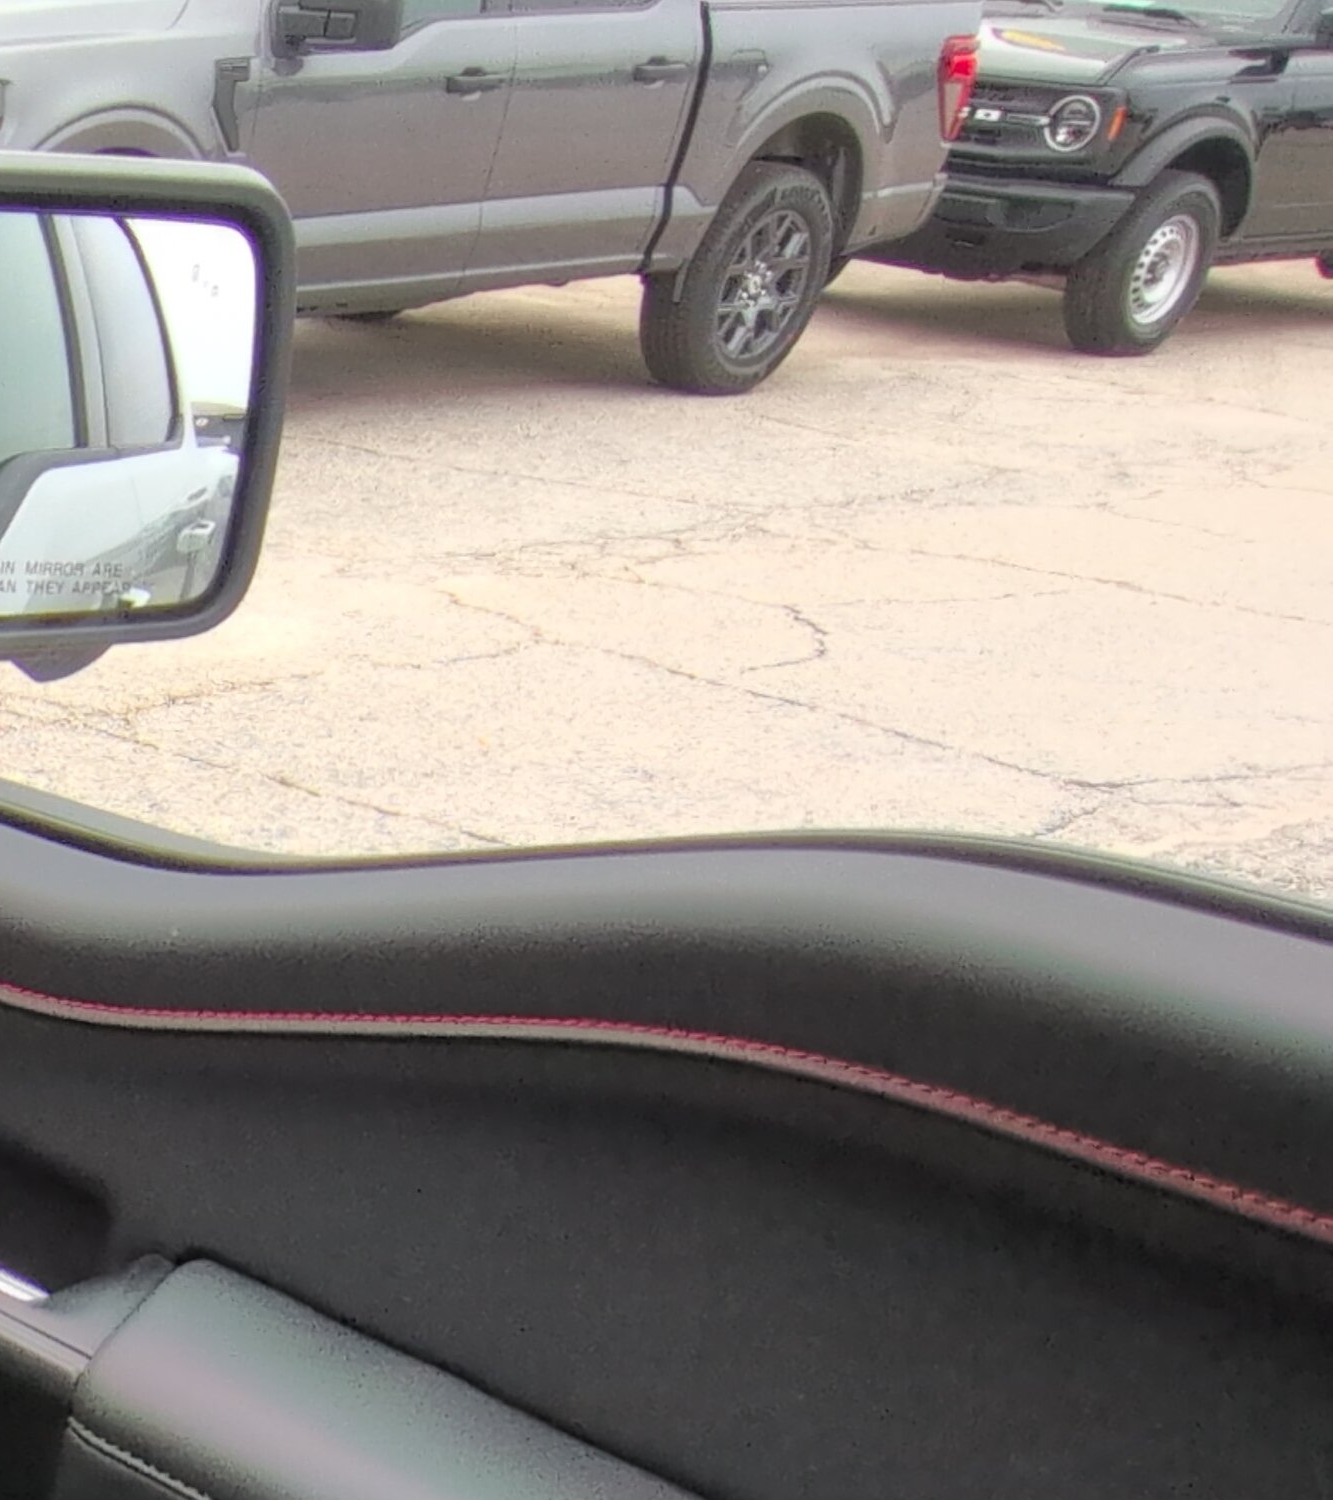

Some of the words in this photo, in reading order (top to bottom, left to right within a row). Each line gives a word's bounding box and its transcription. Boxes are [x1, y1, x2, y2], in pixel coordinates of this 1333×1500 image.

[0, 559, 15, 574] IN
[25, 560, 85, 577] MIRROR
[92, 562, 124, 578] ARE
[26, 579, 66, 595] THEY
